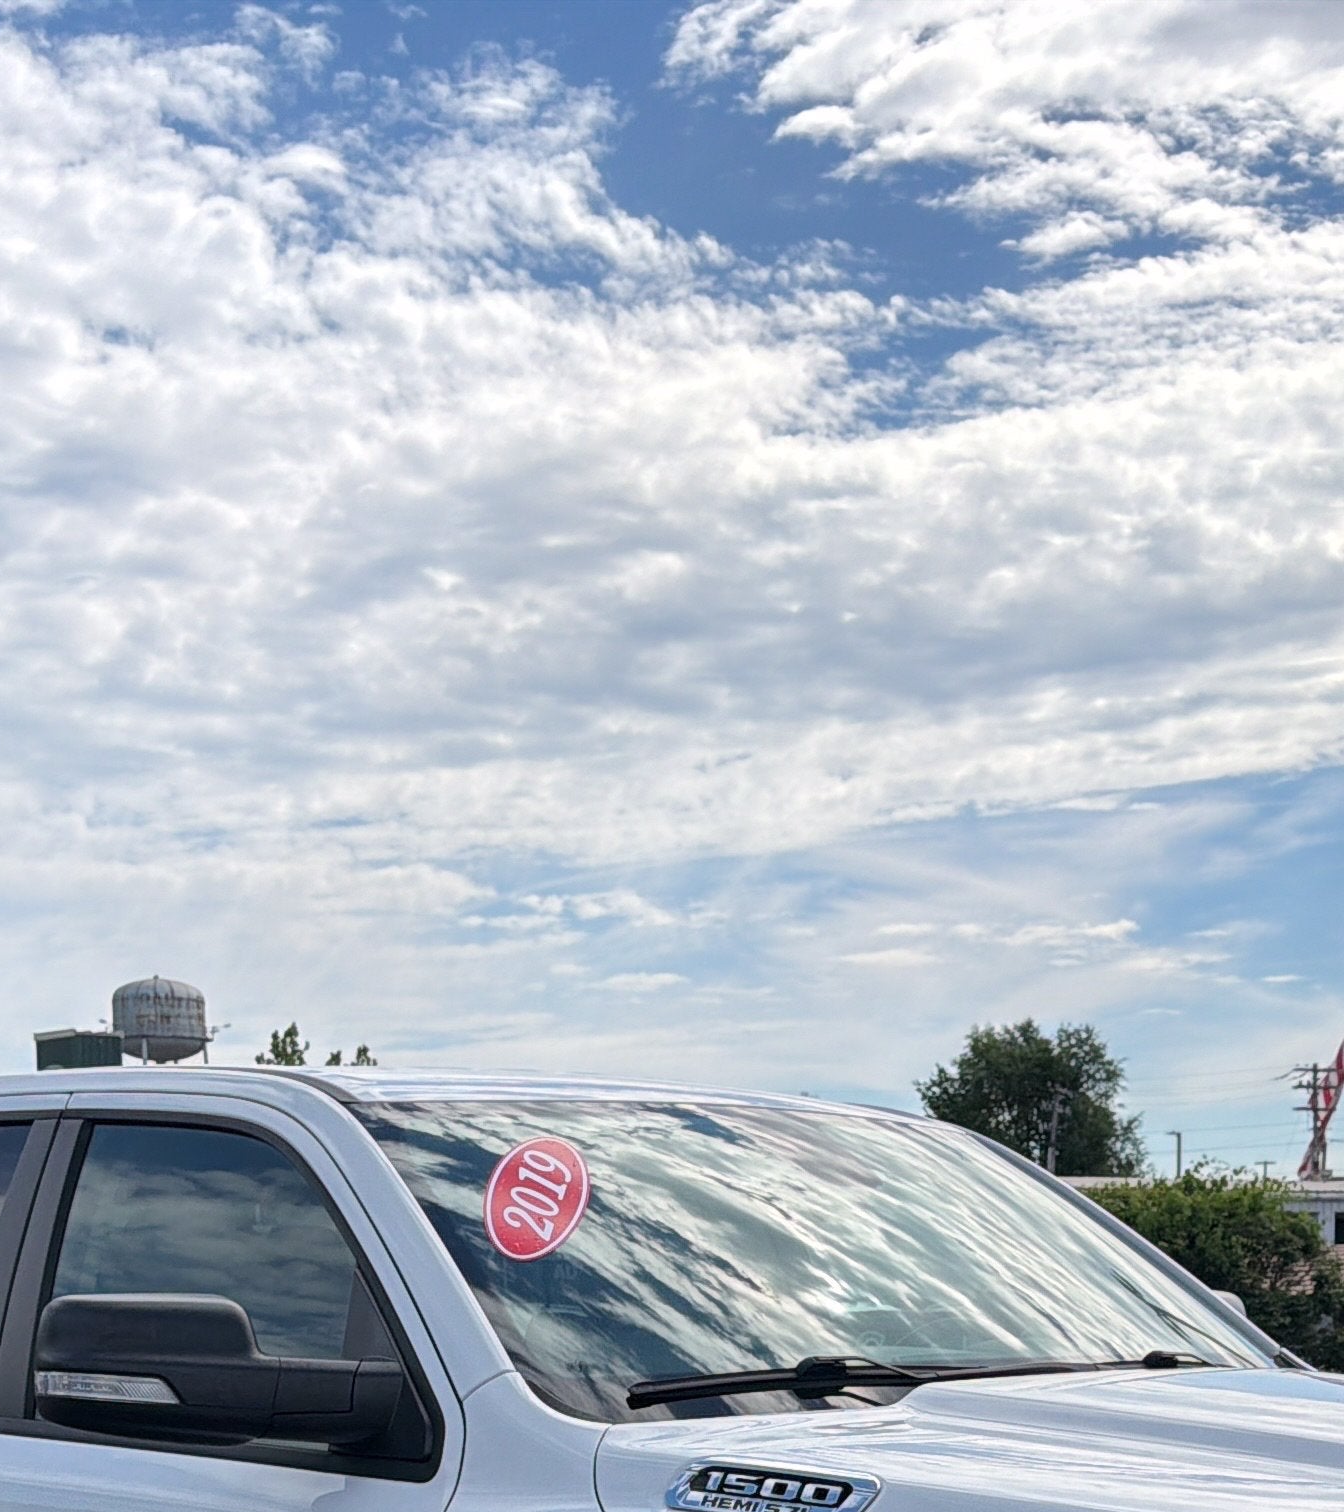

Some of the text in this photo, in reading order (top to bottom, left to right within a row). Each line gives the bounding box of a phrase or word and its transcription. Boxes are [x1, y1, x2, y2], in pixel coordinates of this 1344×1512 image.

[503, 1150, 572, 1242] 2019
[701, 1495, 760, 1512] HEMI
[703, 1471, 844, 1505] 1500
